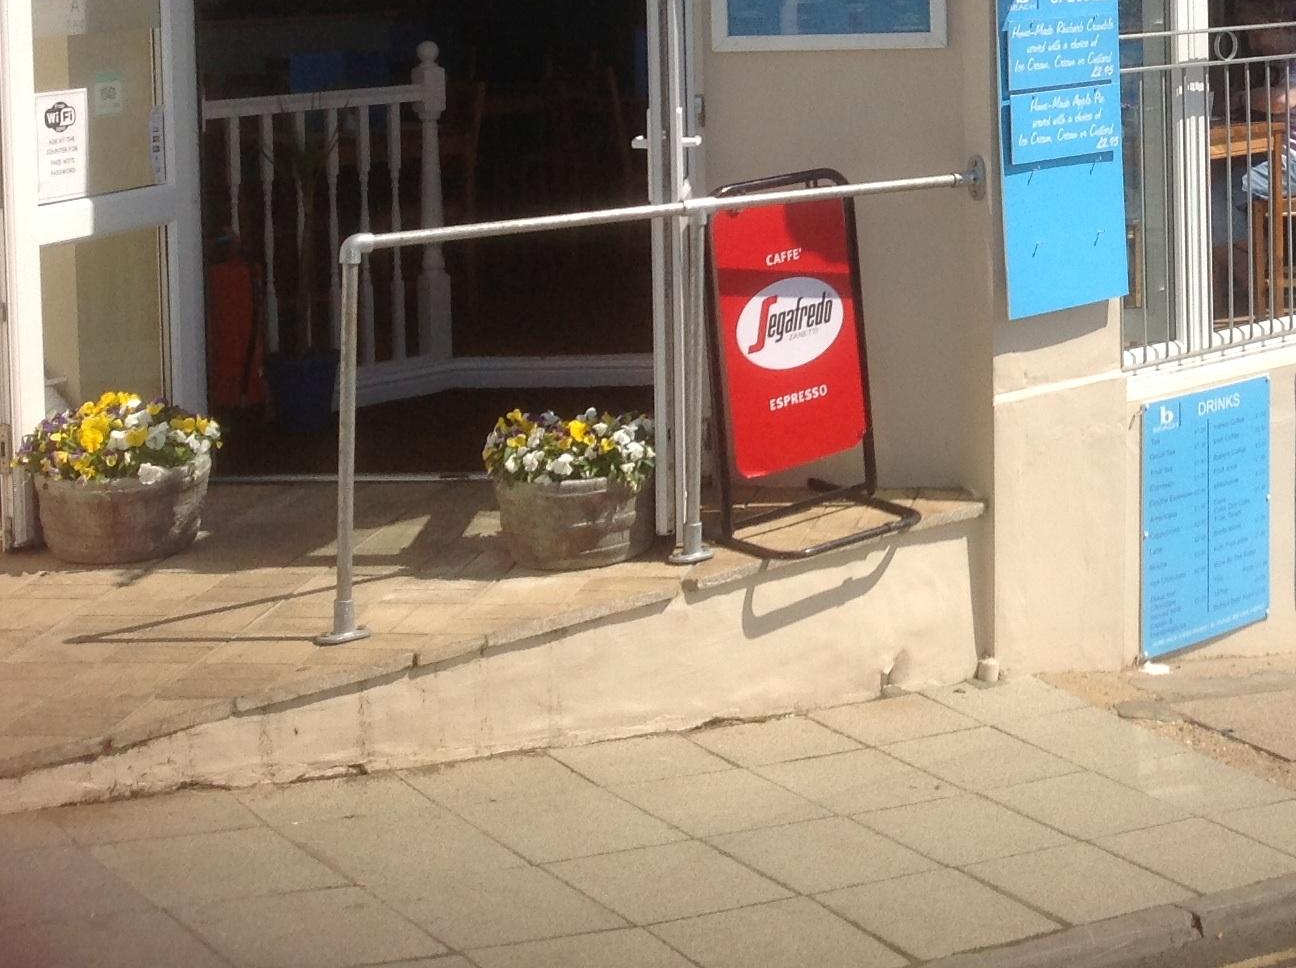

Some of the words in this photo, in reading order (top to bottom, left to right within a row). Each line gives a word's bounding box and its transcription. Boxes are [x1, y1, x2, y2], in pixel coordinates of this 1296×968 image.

[748, 292, 833, 354] Segafredo
[769, 384, 828, 411] ESPRESSO
[1159, 406, 1174, 424] b
[1197, 392, 1241, 417] DRINKS
